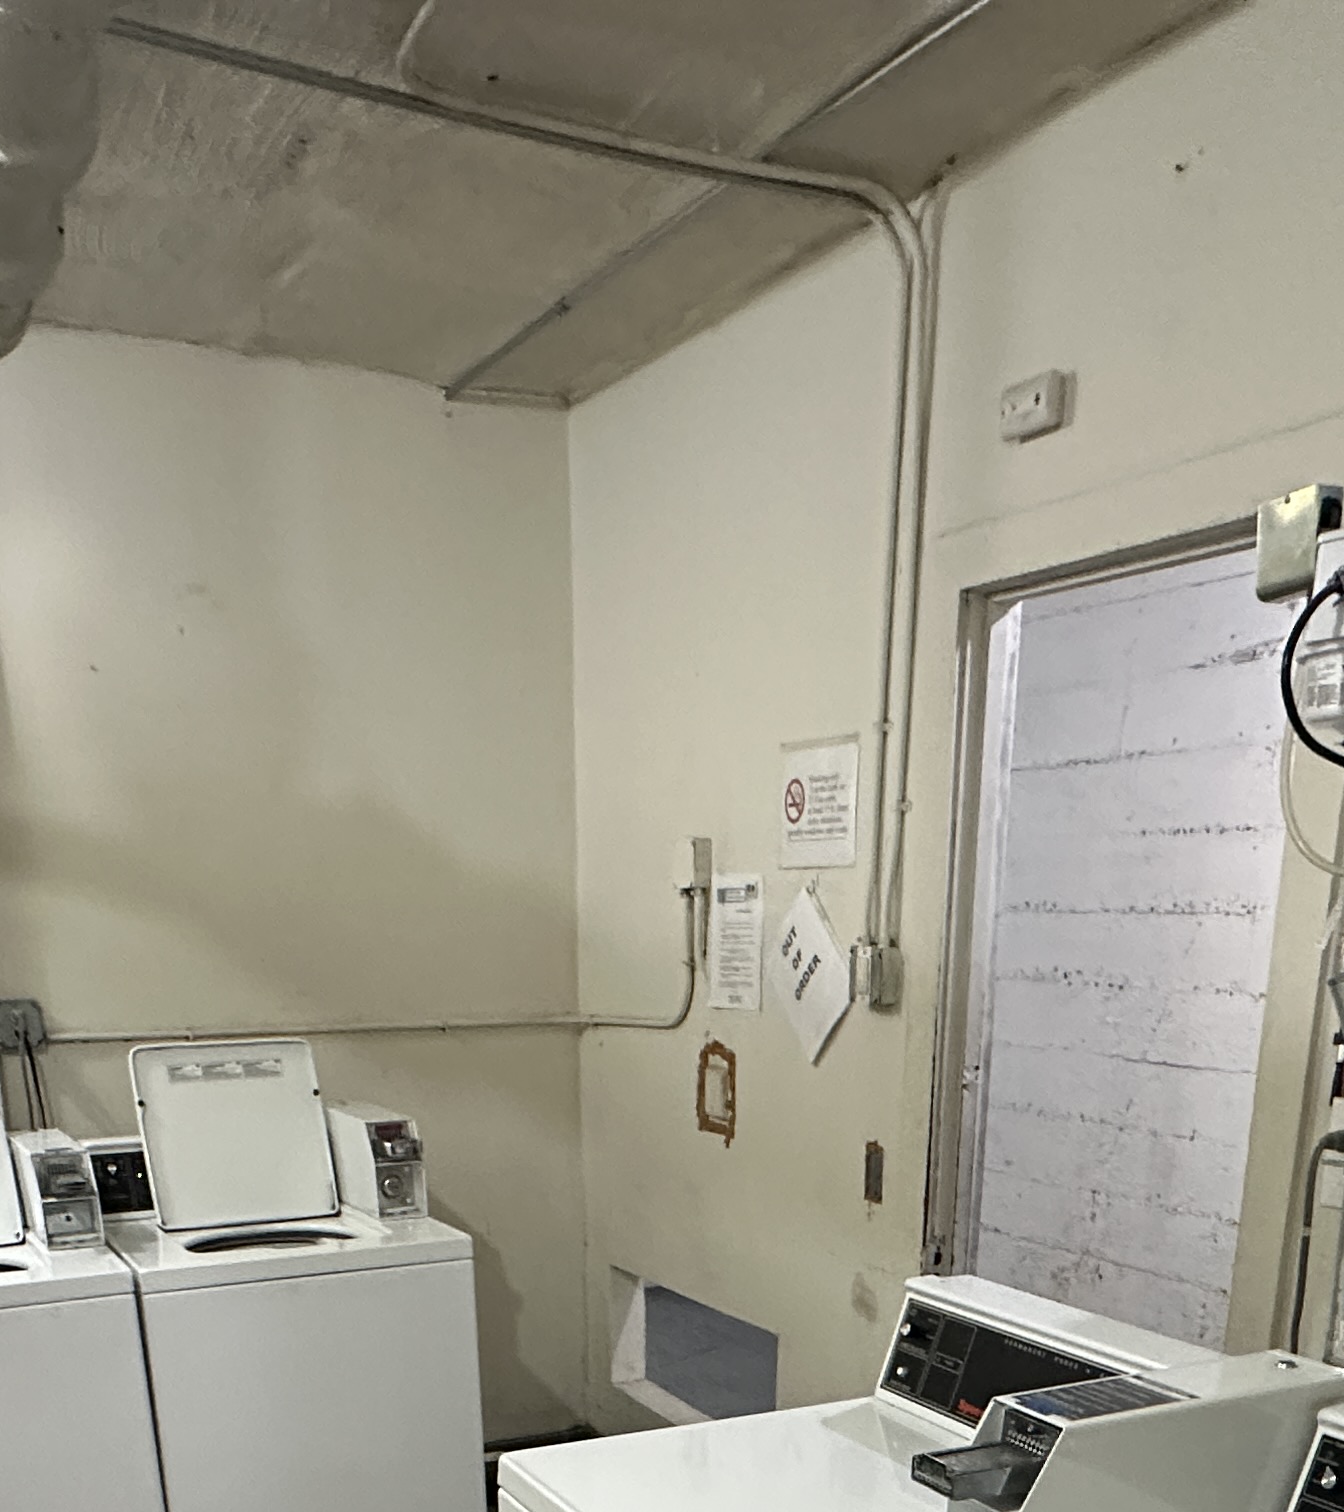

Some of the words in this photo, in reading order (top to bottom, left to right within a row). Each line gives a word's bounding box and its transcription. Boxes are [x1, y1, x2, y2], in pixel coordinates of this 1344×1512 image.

[782, 925, 797, 957] OUT
[792, 948, 802, 970] OF
[795, 954, 821, 1001] ORDER
